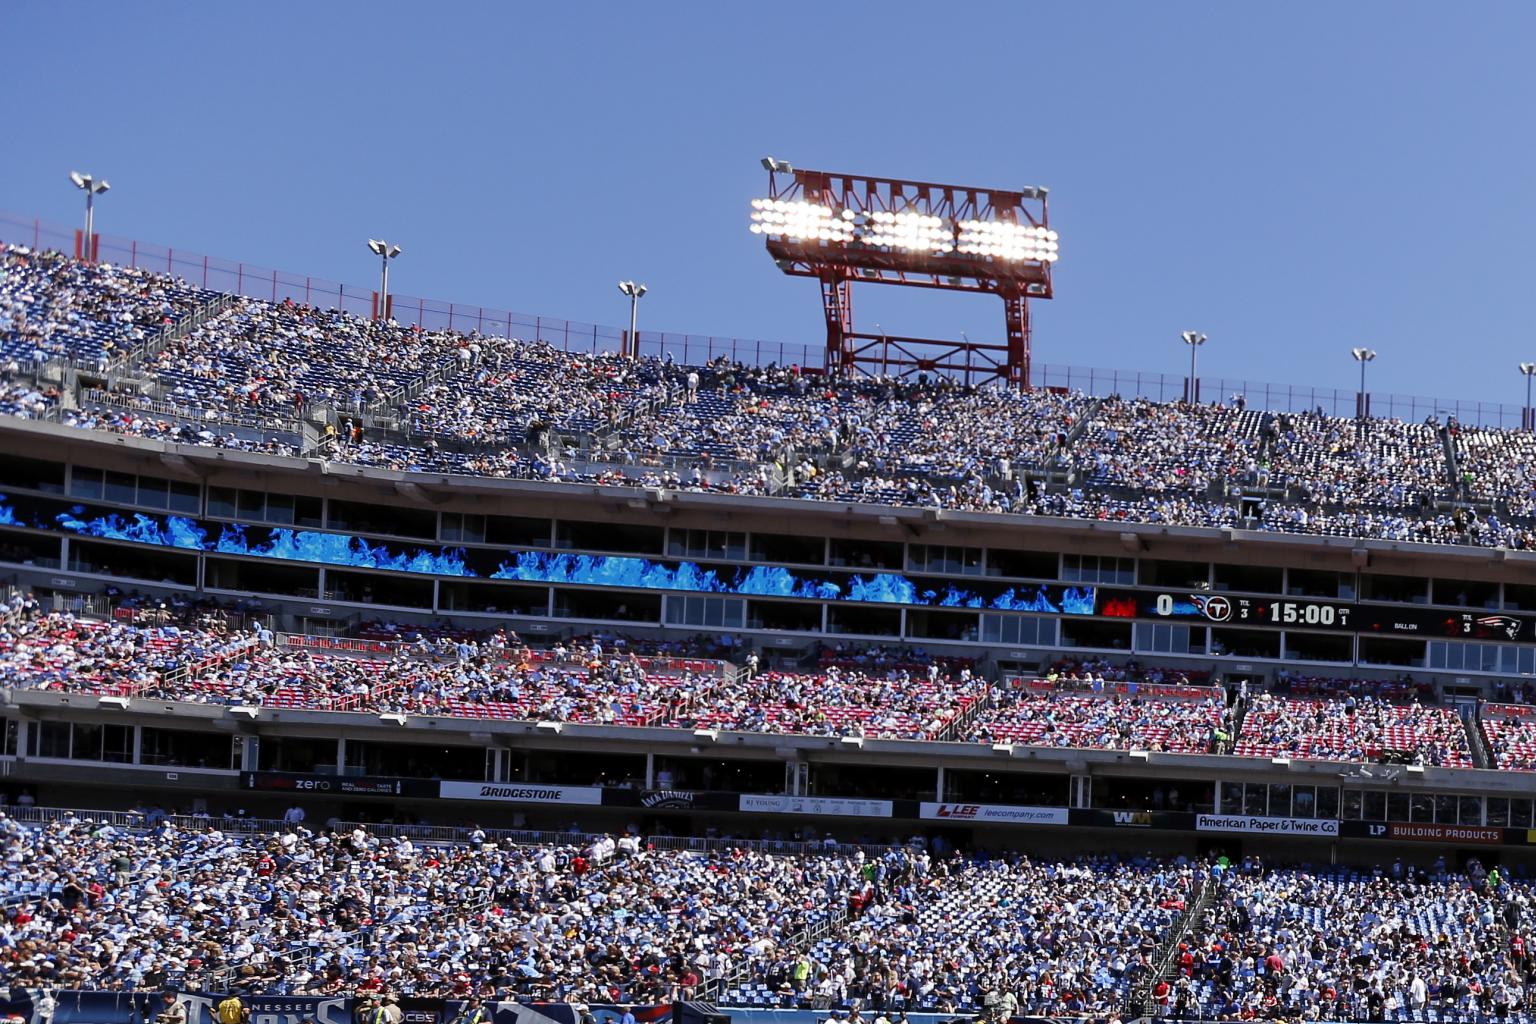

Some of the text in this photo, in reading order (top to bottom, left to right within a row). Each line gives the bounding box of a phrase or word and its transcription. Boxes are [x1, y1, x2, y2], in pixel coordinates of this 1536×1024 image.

[1156, 594, 1173, 616] 0
[1240, 608, 1248, 618] 3
[1270, 602, 1335, 625] 15:00
[1341, 615, 1347, 625] 1
[1463, 623, 1471, 633] 3
[480, 786, 562, 800] BRIDGESTONE
[953, 806, 980, 815] LEE
[984, 807, 1054, 820] leecompany.com
[1200, 815, 1336, 833] American Paper & Twine Co.
[1369, 824, 1499, 840] LP BUILDING PRODUCTS
[406, 1013, 435, 1023] CBS
